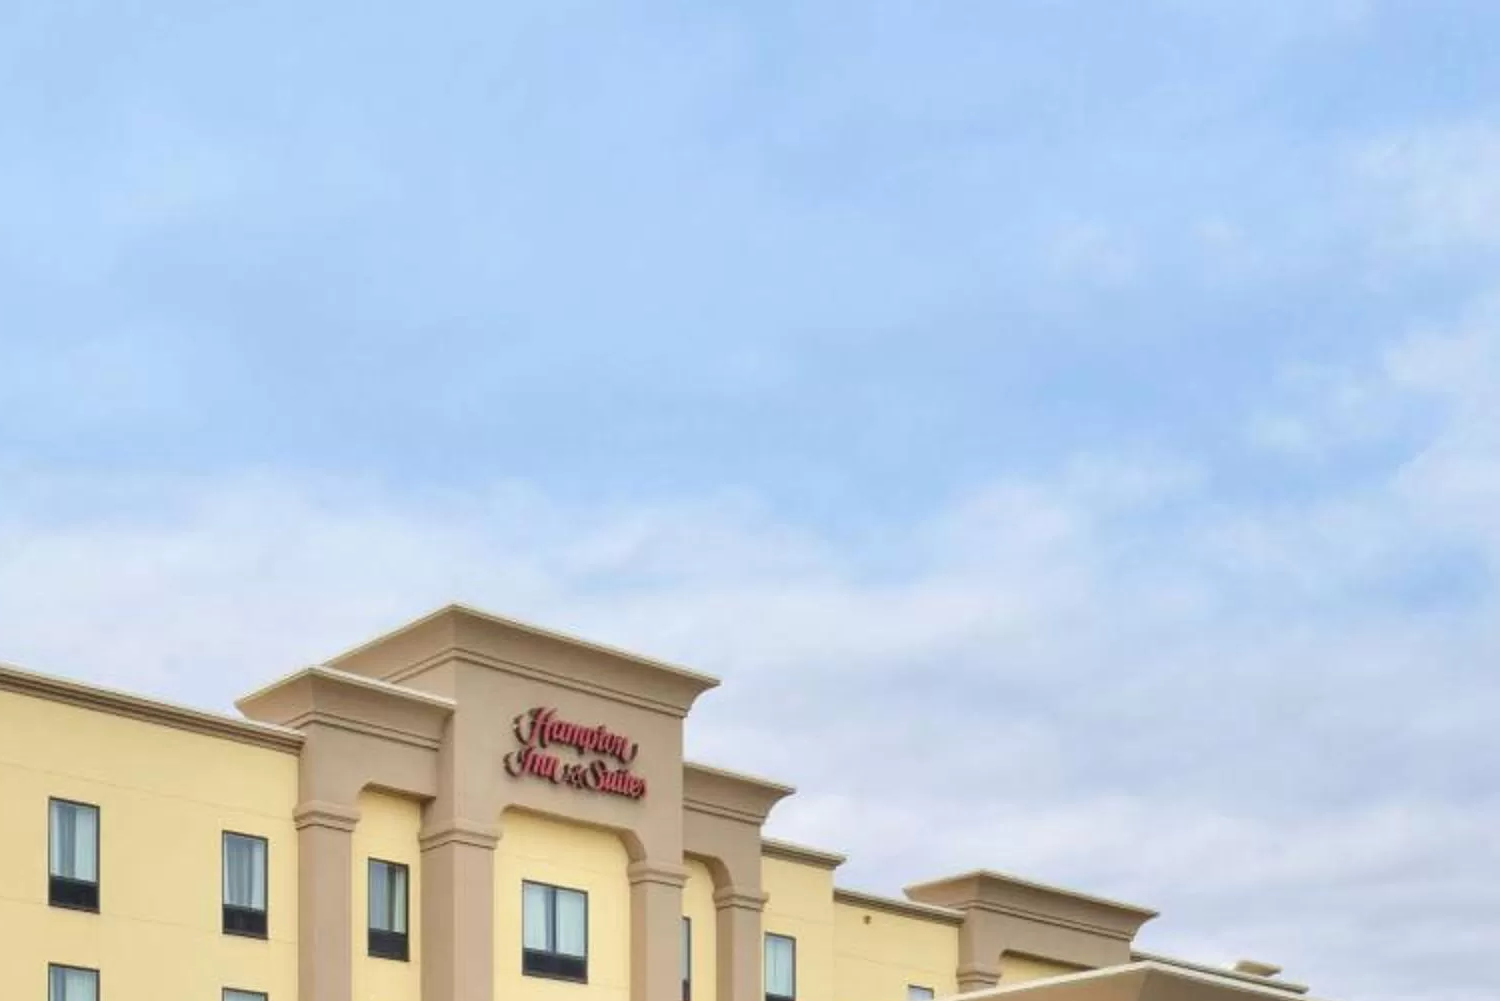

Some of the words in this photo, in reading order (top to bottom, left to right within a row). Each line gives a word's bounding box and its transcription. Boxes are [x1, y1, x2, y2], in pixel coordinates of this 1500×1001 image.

[512, 706, 639, 765] Hampton
[502, 746, 559, 785] Inn
[583, 759, 647, 801] Suites
